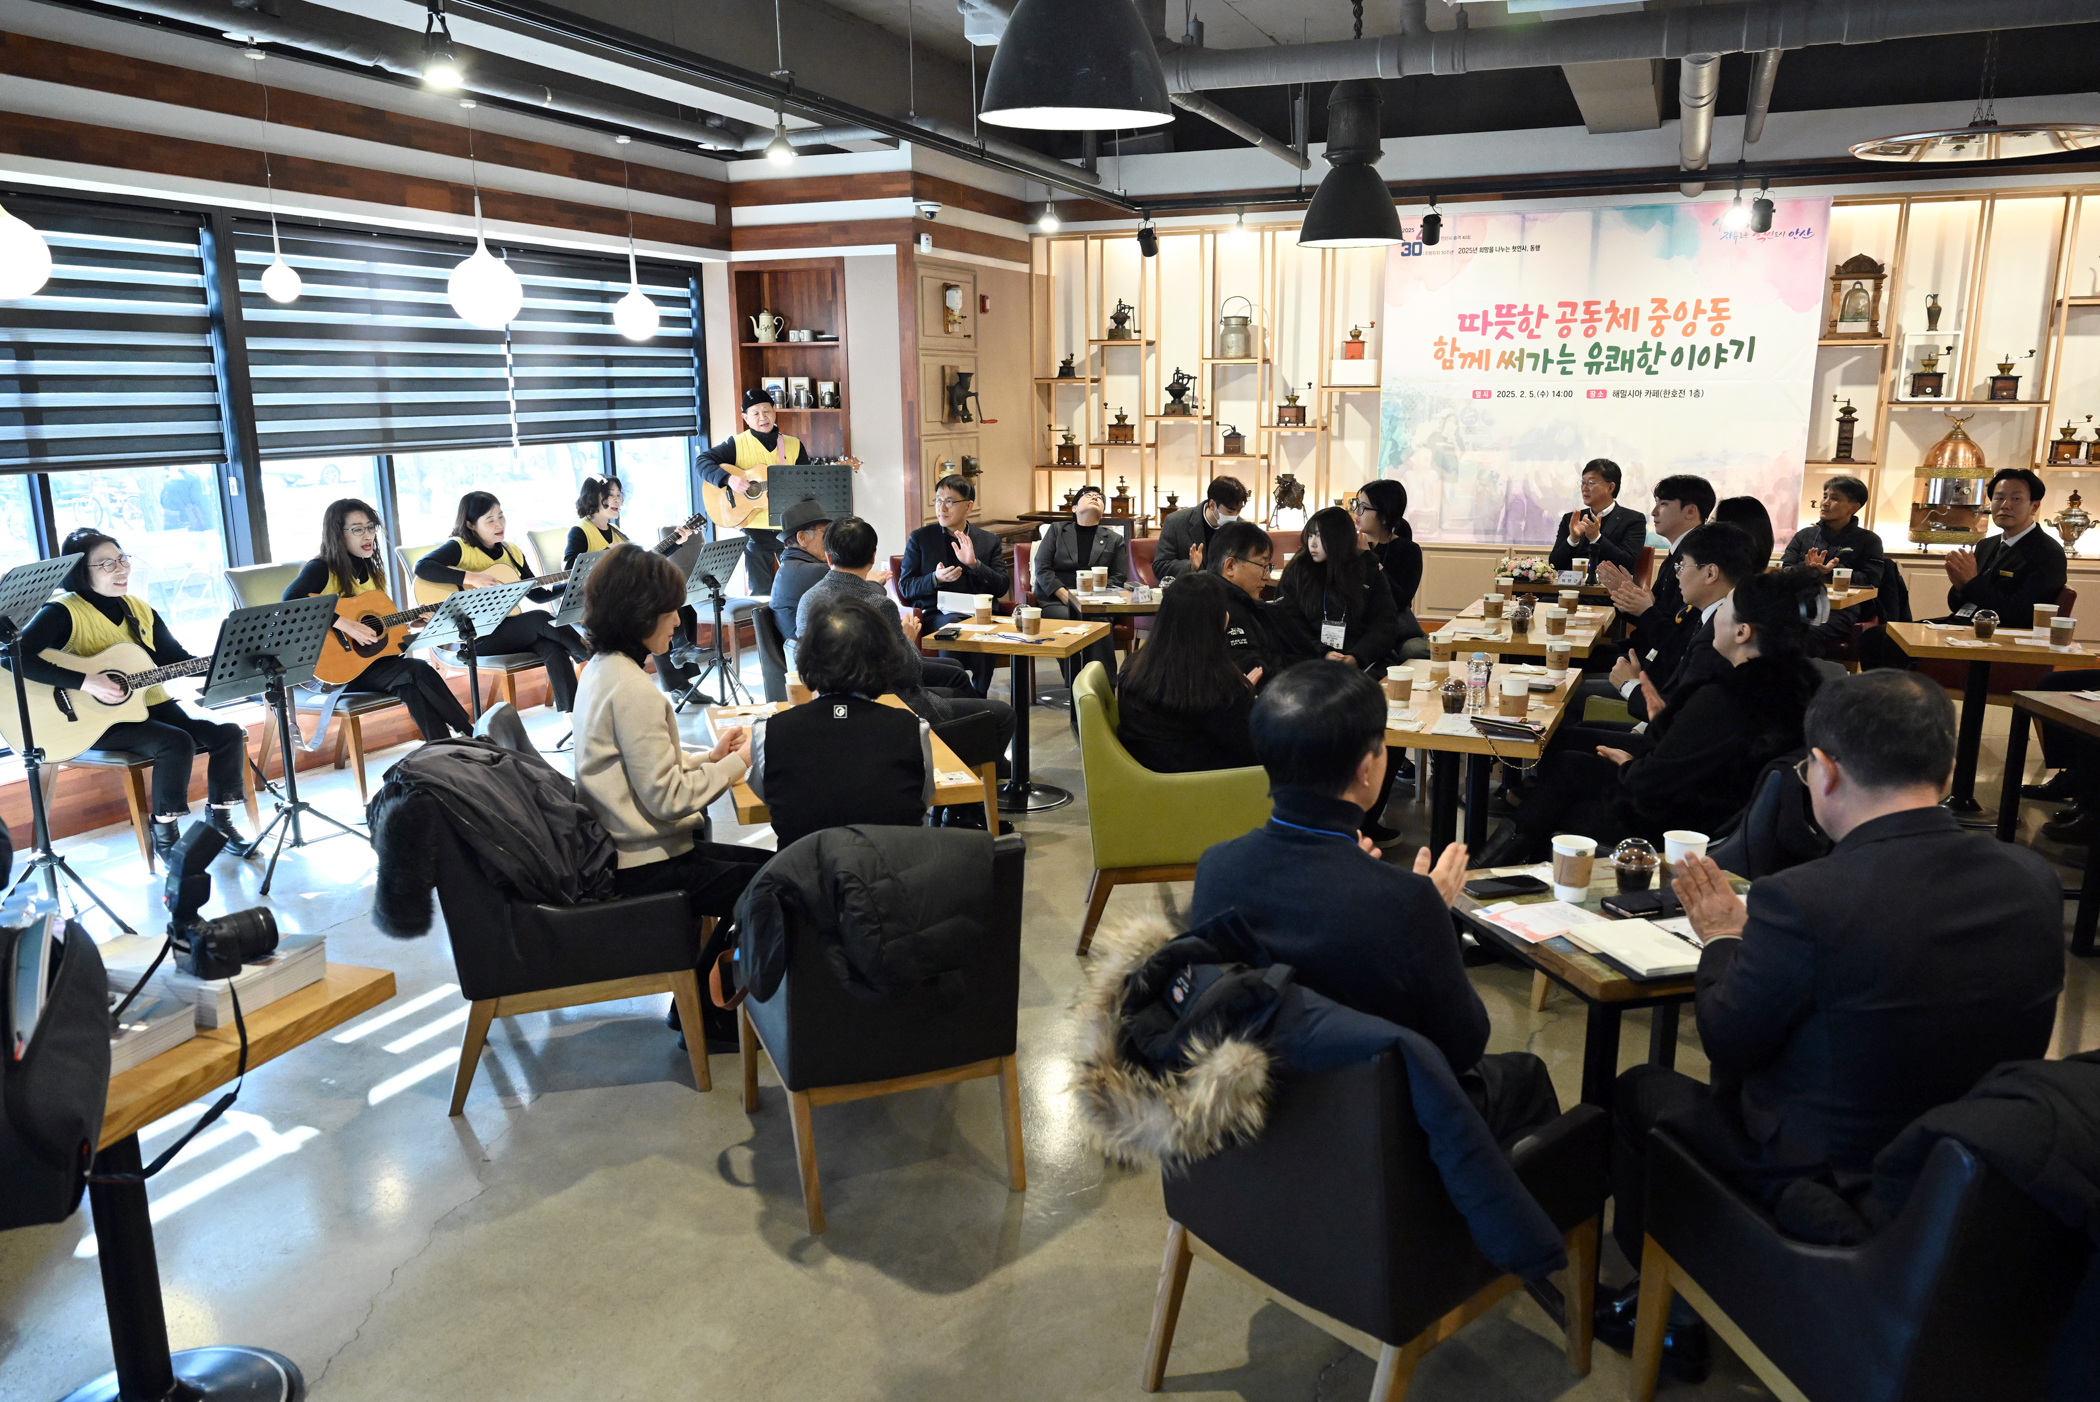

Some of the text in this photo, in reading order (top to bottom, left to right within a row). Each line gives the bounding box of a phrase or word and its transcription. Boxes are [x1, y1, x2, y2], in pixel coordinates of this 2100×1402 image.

[1788, 227, 1815, 239] 안산
[1400, 241, 1423, 257] 30
[1457, 246, 1478, 255] 2025년
[1495, 245, 1510, 253] 나누는
[1457, 297, 1732, 341] 따뜻한 공동체 중앙동
[1433, 335, 1756, 376] 함께 써가는 유쾌한 이야기
[1496, 390, 1517, 399] 2025.
[1519, 390, 1527, 399] 2.
[1552, 390, 1574, 399] 14:00
[1689, 389, 1705, 398] 1층)
